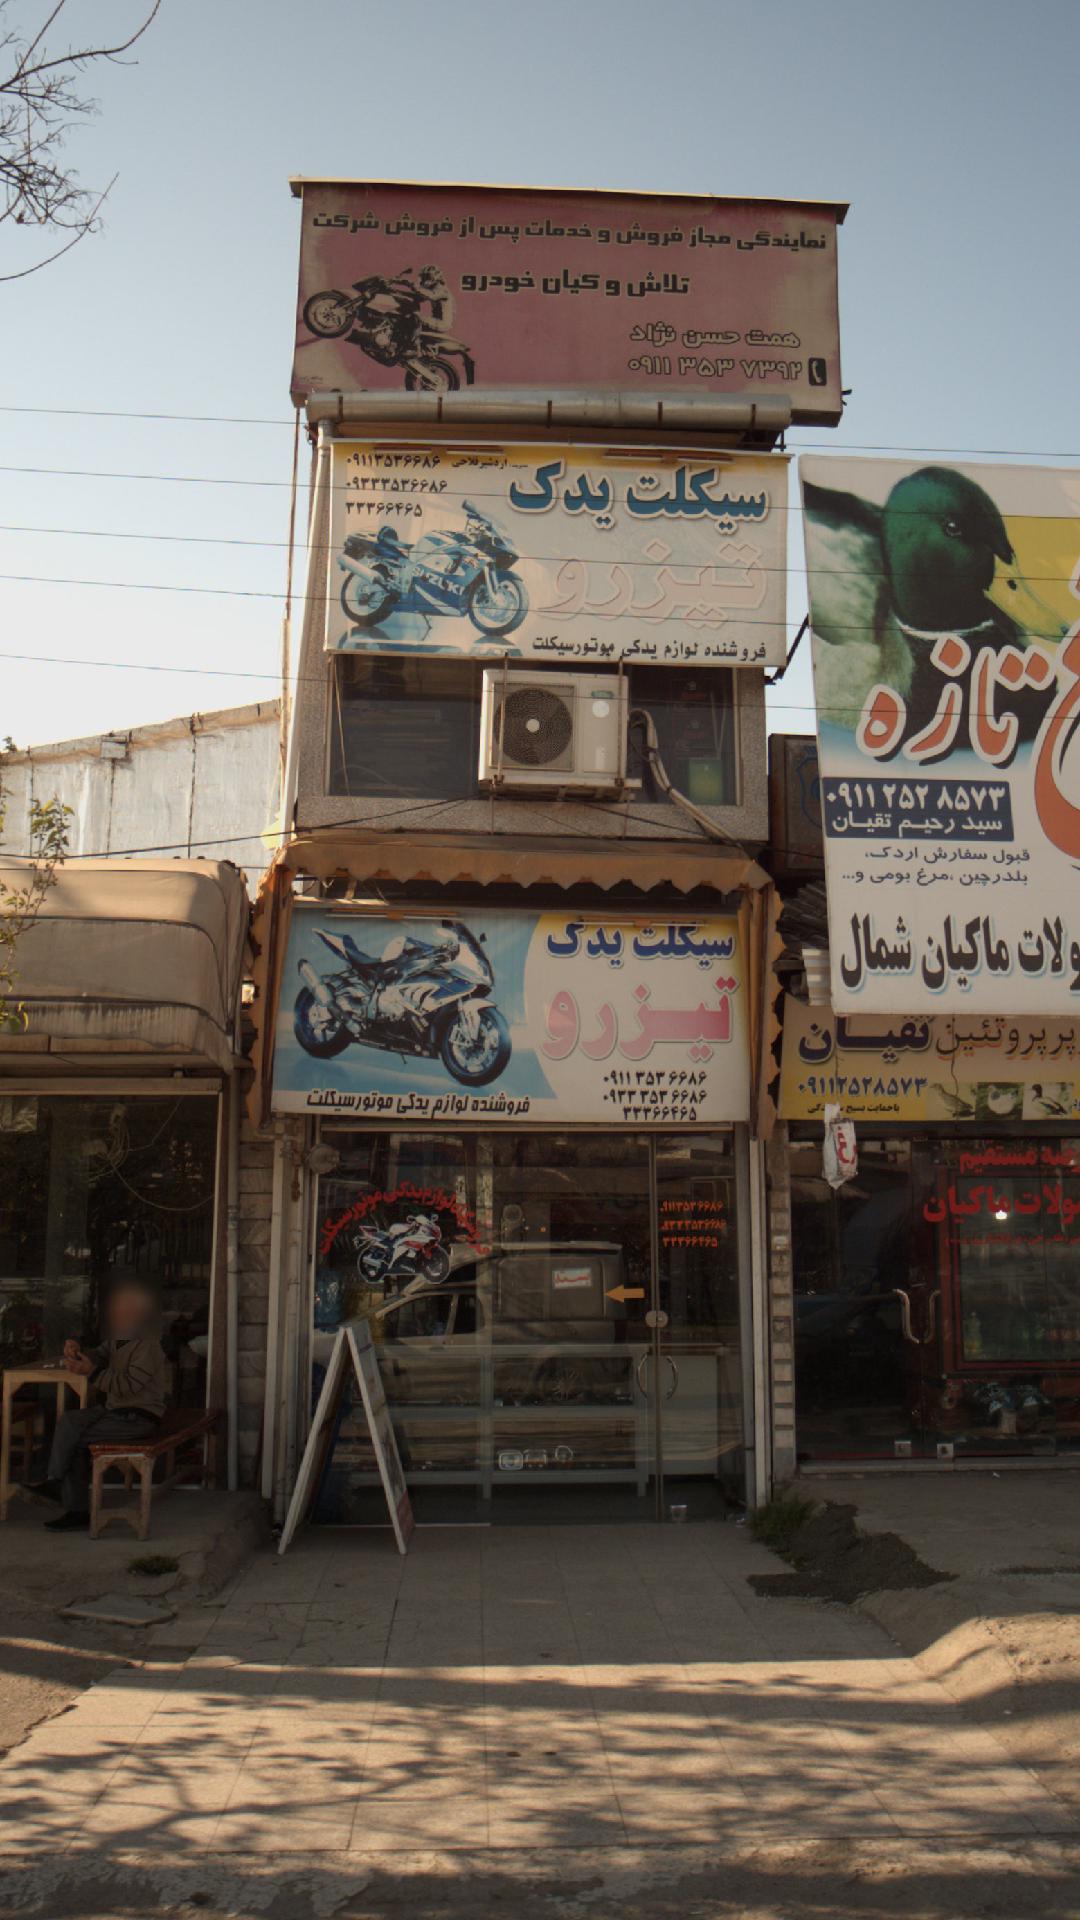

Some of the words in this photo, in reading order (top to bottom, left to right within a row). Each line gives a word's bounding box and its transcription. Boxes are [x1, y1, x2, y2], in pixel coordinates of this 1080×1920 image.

[313, 212, 379, 232] شرکت
[385, 214, 453, 236] فروش
[459, 215, 474, 237] از
[525, 220, 593, 239] خدمات
[479, 222, 519, 244] پس
[598, 227, 610, 243] و
[616, 223, 683, 247] فروش
[689, 226, 731, 247] مجاز
[736, 229, 826, 250] نمایندگی
[461, 270, 534, 293] خودرو
[542, 269, 600, 295] کیان
[605, 276, 620, 297] و
[626, 272, 690, 297] تلاش
[630, 321, 676, 347] نژاد
[682, 329, 740, 348] حسن
[746, 330, 800, 349] همت
[628, 356, 672, 375] ۰۹۱۱
[679, 357, 735, 377] ۳۵۳
[740, 359, 803, 380] ۷۳۹۲
[345, 453, 442, 470] ۰۹۱۱۳۵۳۶۶۸۶
[345, 477, 448, 494] ۰۹۳۳۳۵۳۶۶۸۶
[509, 459, 614, 530] یدک
[626, 462, 768, 534] سیکلت
[345, 502, 423, 517] ۳۳۳۶۶۴۶۵
[538, 538, 768, 630] تیزرو
[621, 639, 657, 659] یدکی
[664, 642, 698, 659] لوازم
[705, 641, 767, 661] فروشنده
[857, 635, 1055, 763] تازه
[826, 782, 875, 810] ۰۹۱۱
[882, 783, 929, 810] ۲۵۲
[937, 785, 1006, 811] ۸۵۷۳
[832, 810, 892, 832] تقیان
[898, 817, 955, 838] رحیم
[961, 816, 1003, 835] سید
[923, 848, 988, 864] سفارش
[993, 850, 1031, 864] قبول
[869, 871, 911, 885] بومی
[959, 870, 1028, 886] بلدرچین
[547, 922, 622, 968] یدک
[632, 922, 734, 968] سیکلت
[841, 912, 912, 987] شمال
[922, 914, 1010, 988] ماکیان
[541, 976, 739, 1060] تیزرو
[936, 1017, 1046, 1056] پروتئین
[603, 1071, 632, 1086] ۰۹۱۱
[635, 1071, 666, 1086] ۳۵۳
[669, 1071, 708, 1087] ۶۶۸۶
[798, 1076, 928, 1096] ۰۹۱۱۲۵۲۸۵۷۳
[306, 1089, 393, 1112] موتورسیکلت
[396, 1092, 429, 1115] یدکی
[432, 1097, 469, 1118] لوازم
[471, 1095, 531, 1114] فروشنده
[603, 1089, 636, 1104] ۰۹۳۳
[639, 1089, 666, 1104] ۳۵۳
[669, 1089, 708, 1105] ۶۶۸۶
[960, 1145, 1038, 1174] مستقیم
[922, 1184, 1010, 1224] ماکیان
